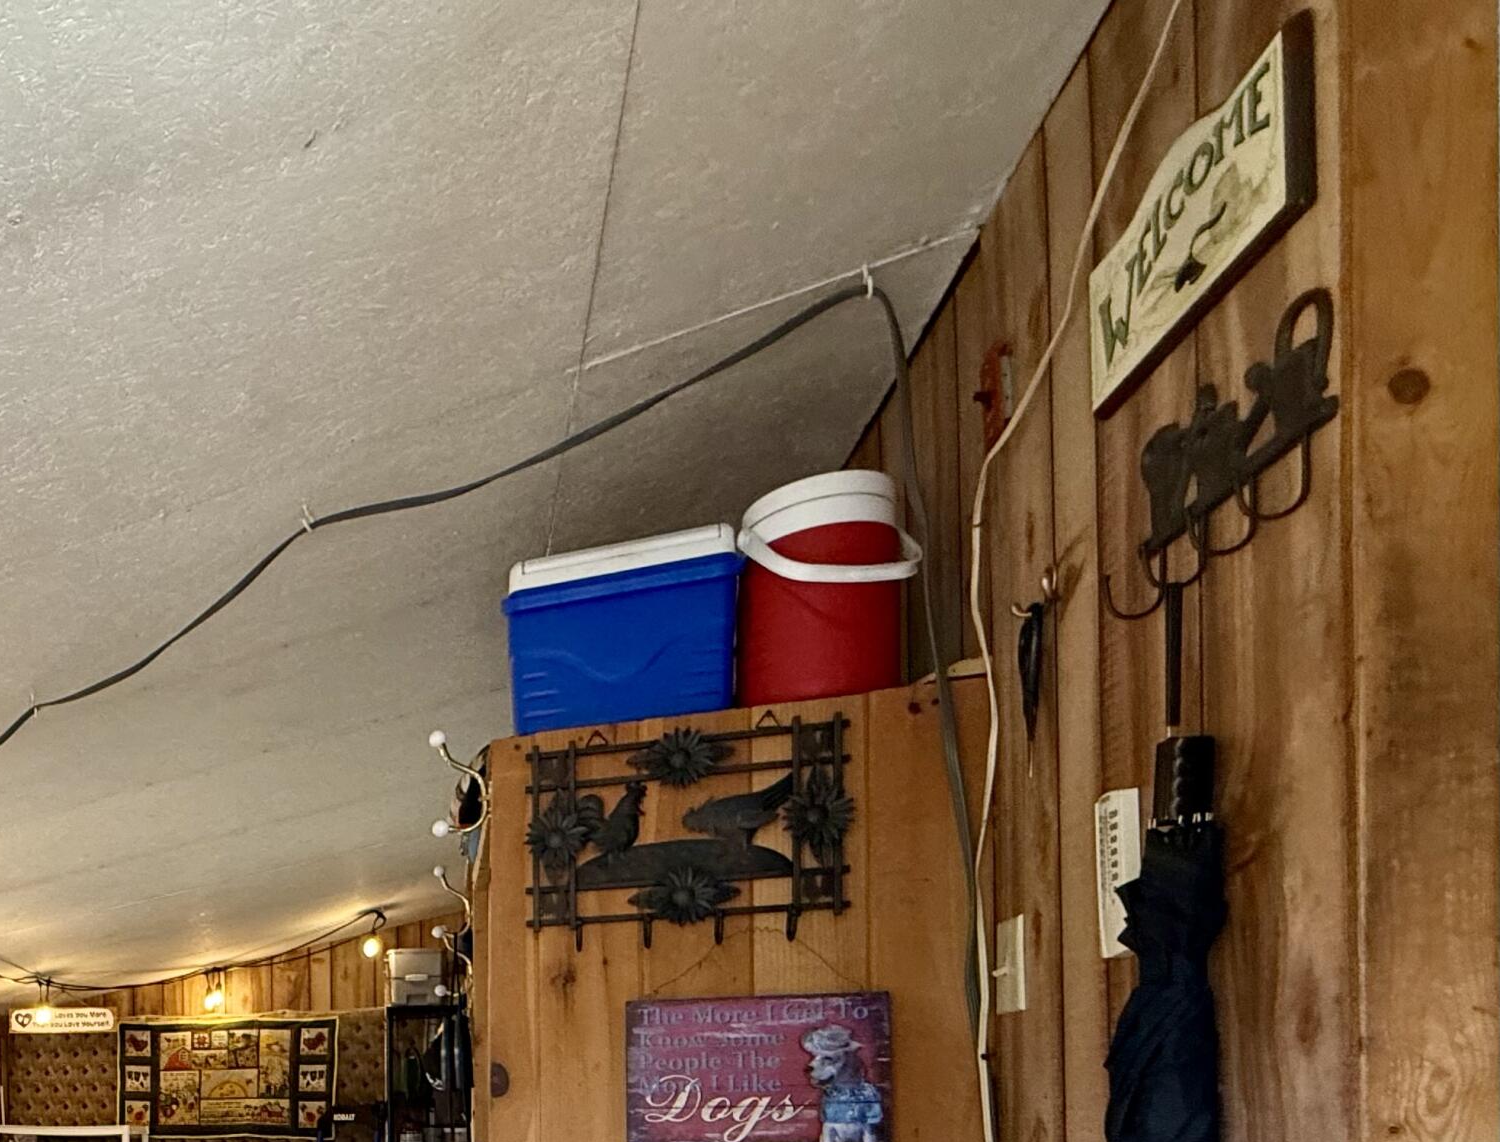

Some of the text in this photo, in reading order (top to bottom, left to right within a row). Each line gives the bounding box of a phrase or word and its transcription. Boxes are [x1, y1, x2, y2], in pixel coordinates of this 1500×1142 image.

[1098, 61, 1271, 369] WELCOME
[638, 1007, 683, 1026] The
[691, 1006, 757, 1025] More
[765, 1004, 775, 1022] I
[836, 1000, 869, 1020] To
[638, 1031, 706, 1048] Know
[638, 1050, 781, 1074] People The
[711, 1074, 720, 1092] I
[728, 1073, 783, 1092] Like
